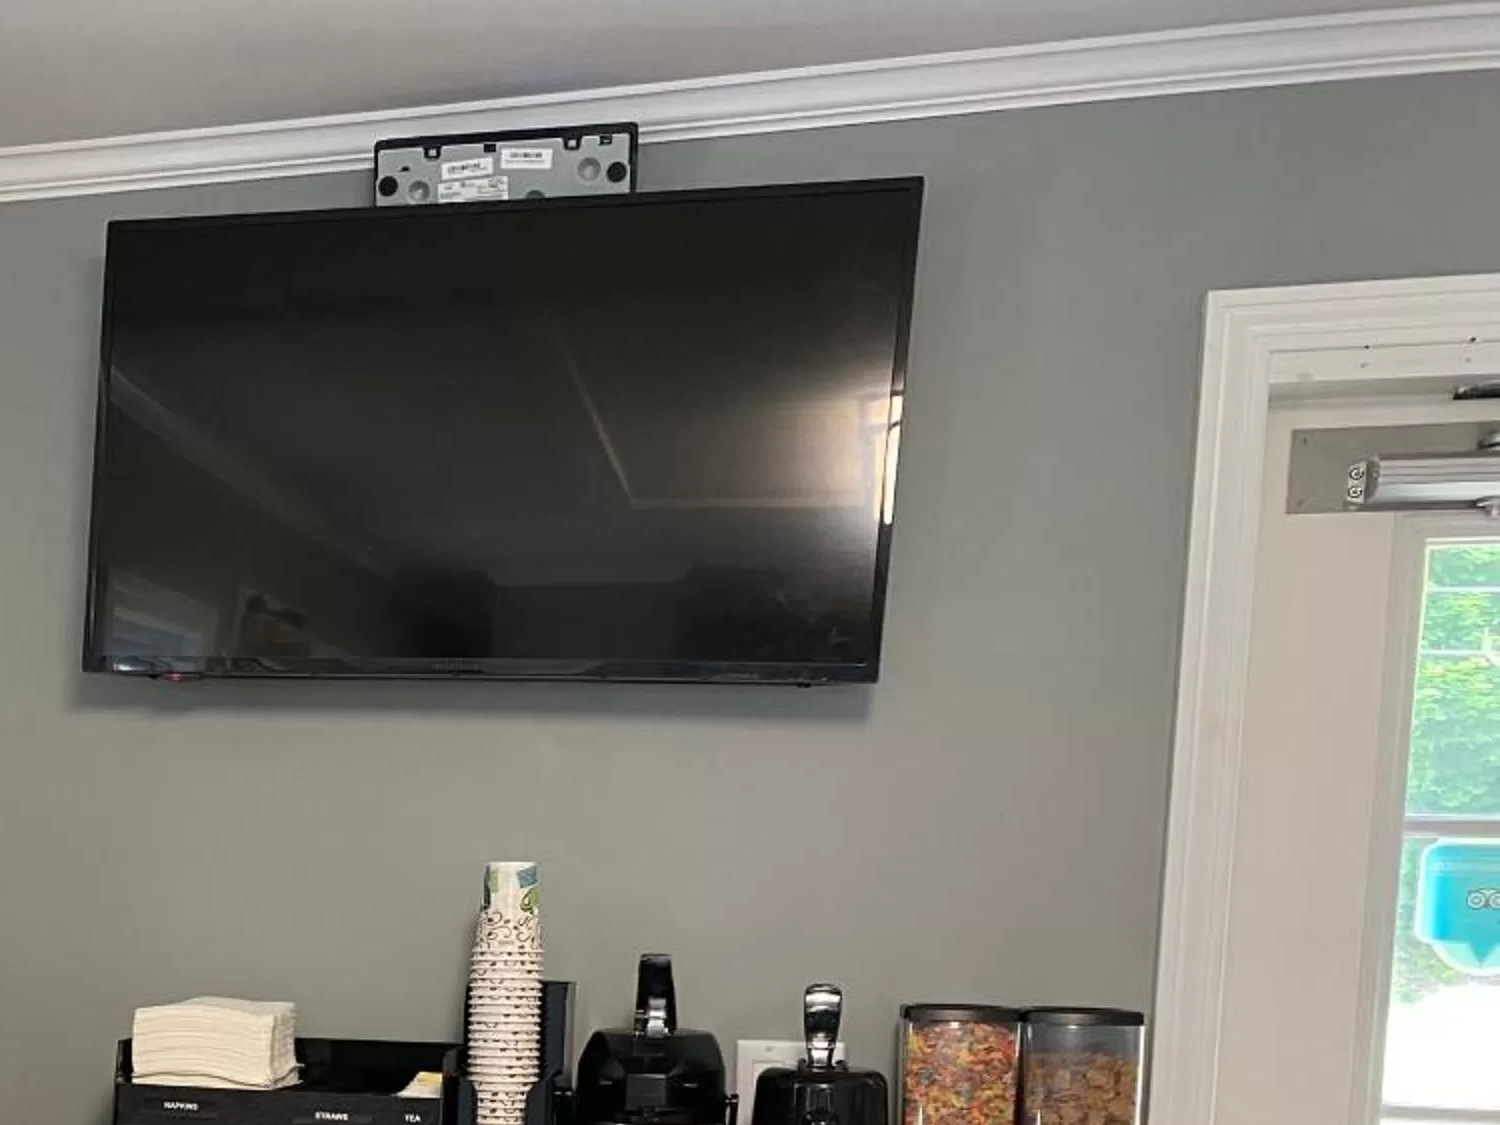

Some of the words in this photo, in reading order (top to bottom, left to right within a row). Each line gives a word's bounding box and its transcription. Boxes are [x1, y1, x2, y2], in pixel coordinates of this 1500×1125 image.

[163, 1101, 199, 1112] NAPKINS
[315, 1111, 349, 1121] STRAWS
[404, 1113, 421, 1123] TEA
